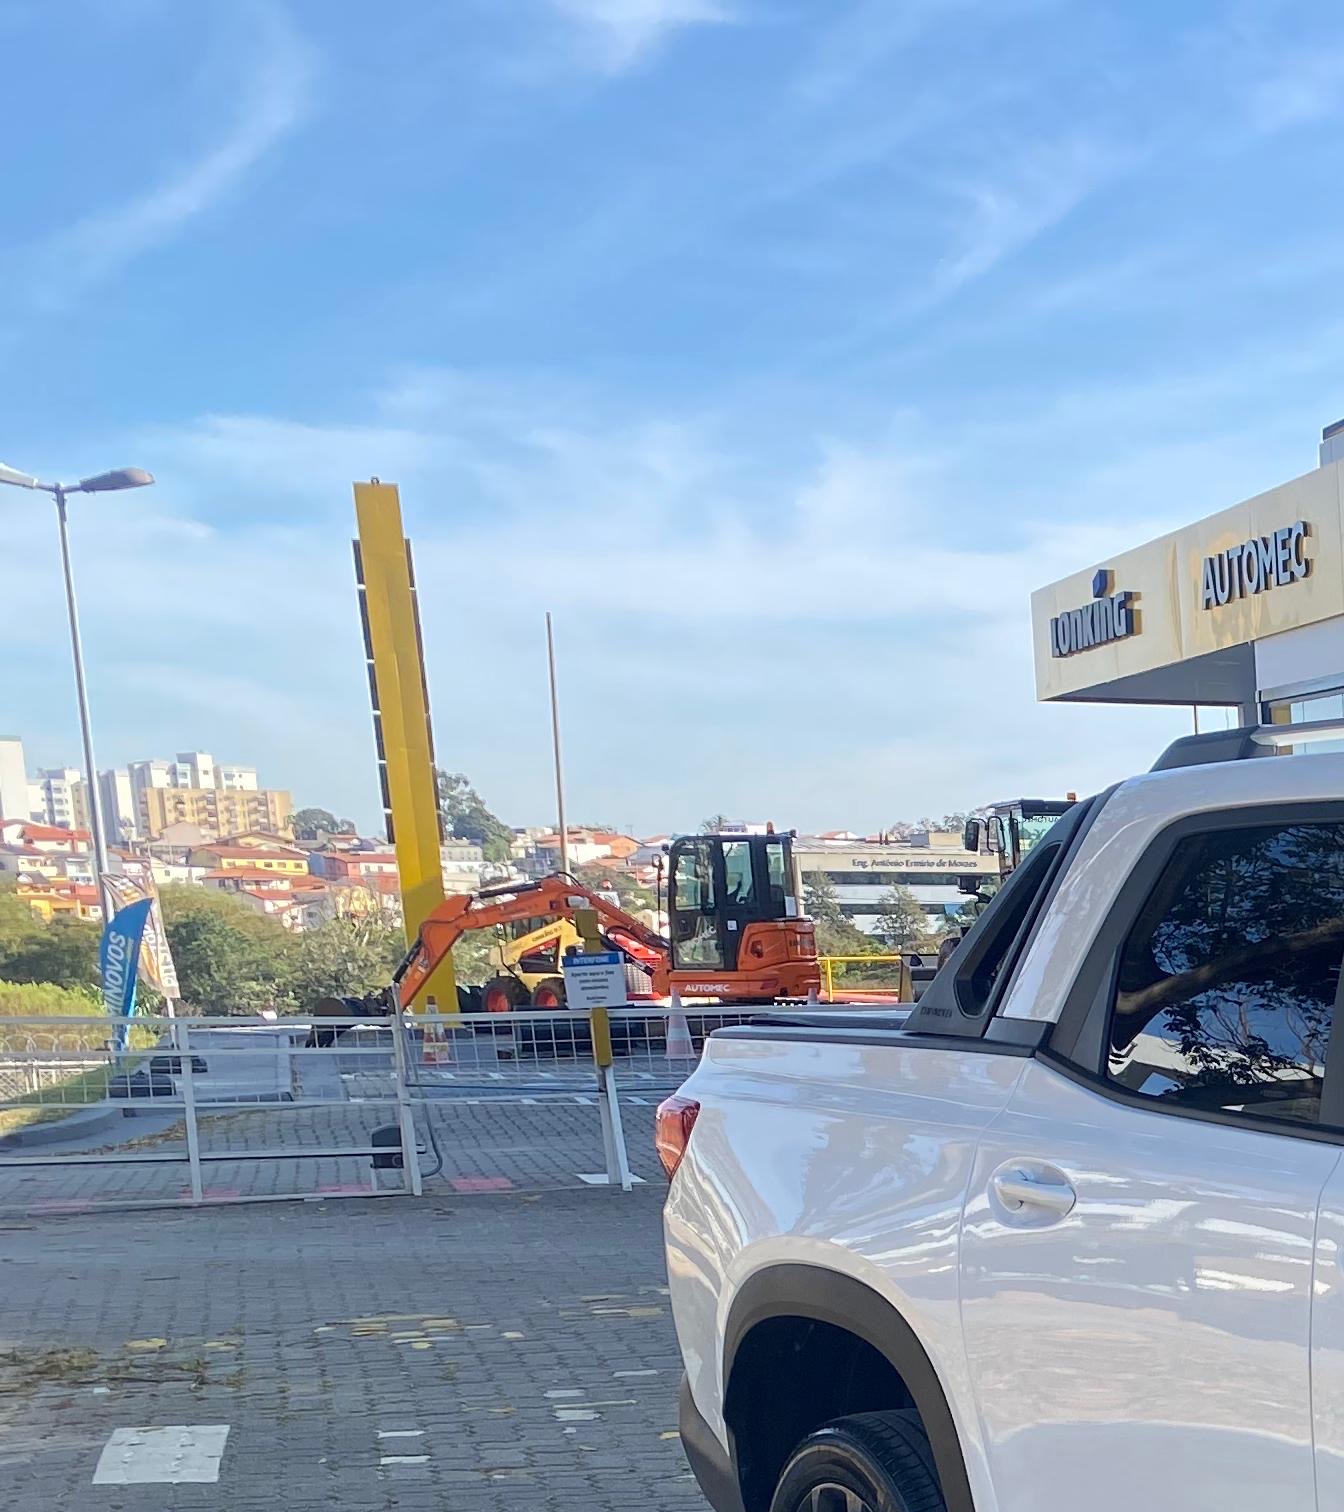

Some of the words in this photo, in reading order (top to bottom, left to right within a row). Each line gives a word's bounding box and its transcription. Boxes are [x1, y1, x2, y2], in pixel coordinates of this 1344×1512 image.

[1202, 520, 1309, 610] AUTOMEC
[936, 859, 947, 867] de
[684, 983, 730, 993] AUTOMEC
